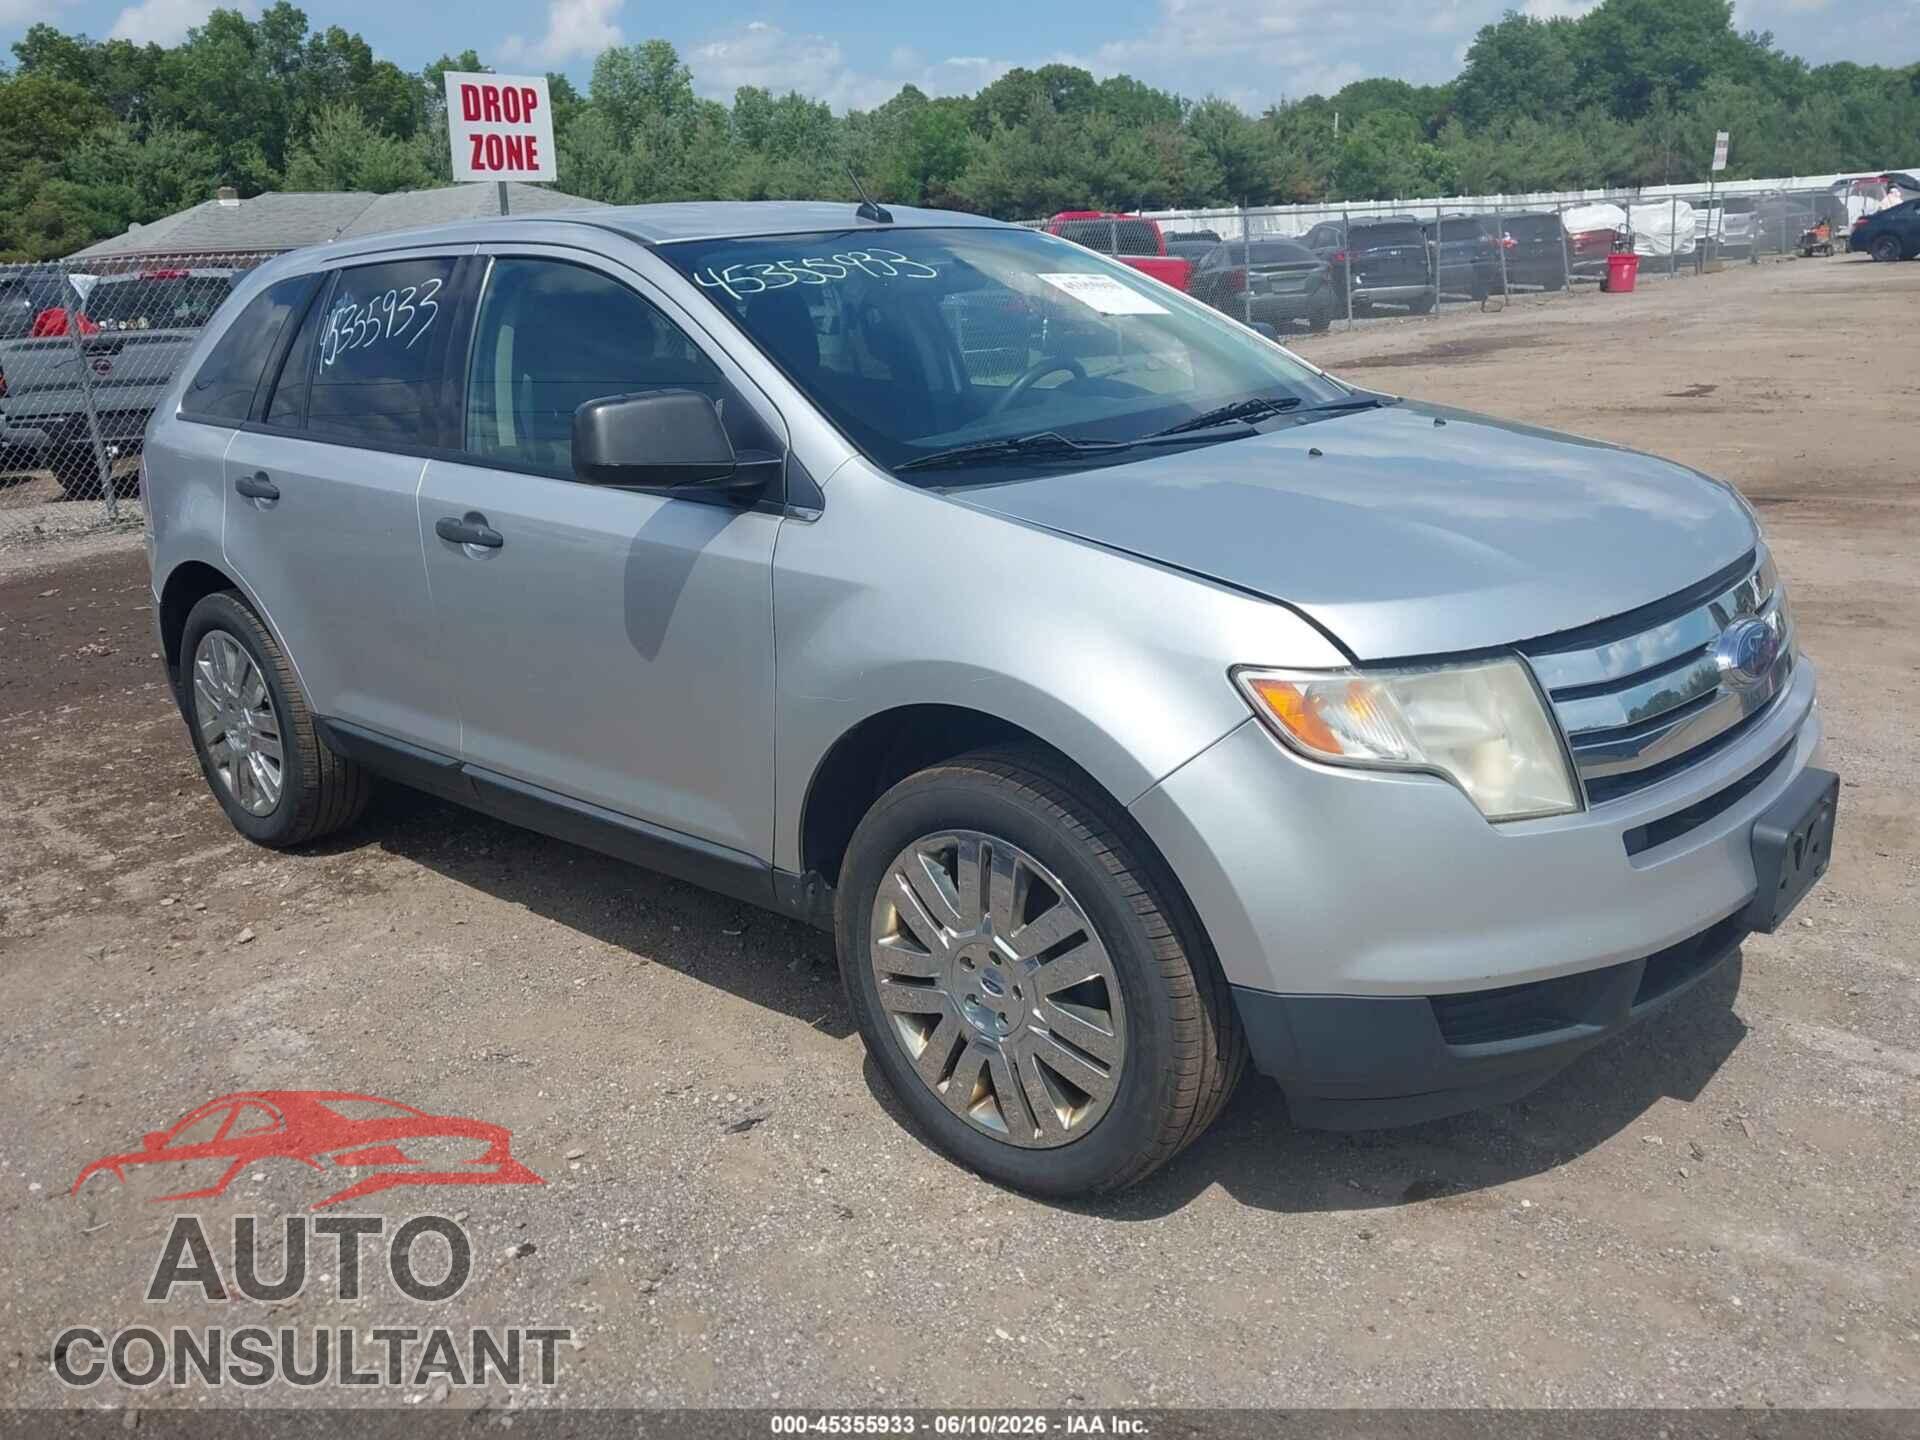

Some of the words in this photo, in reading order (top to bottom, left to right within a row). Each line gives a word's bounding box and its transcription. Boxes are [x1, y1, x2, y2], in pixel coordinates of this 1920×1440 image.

[461, 84, 538, 123] DROP
[469, 134, 539, 171] ZONE
[693, 248, 937, 300] 45355933
